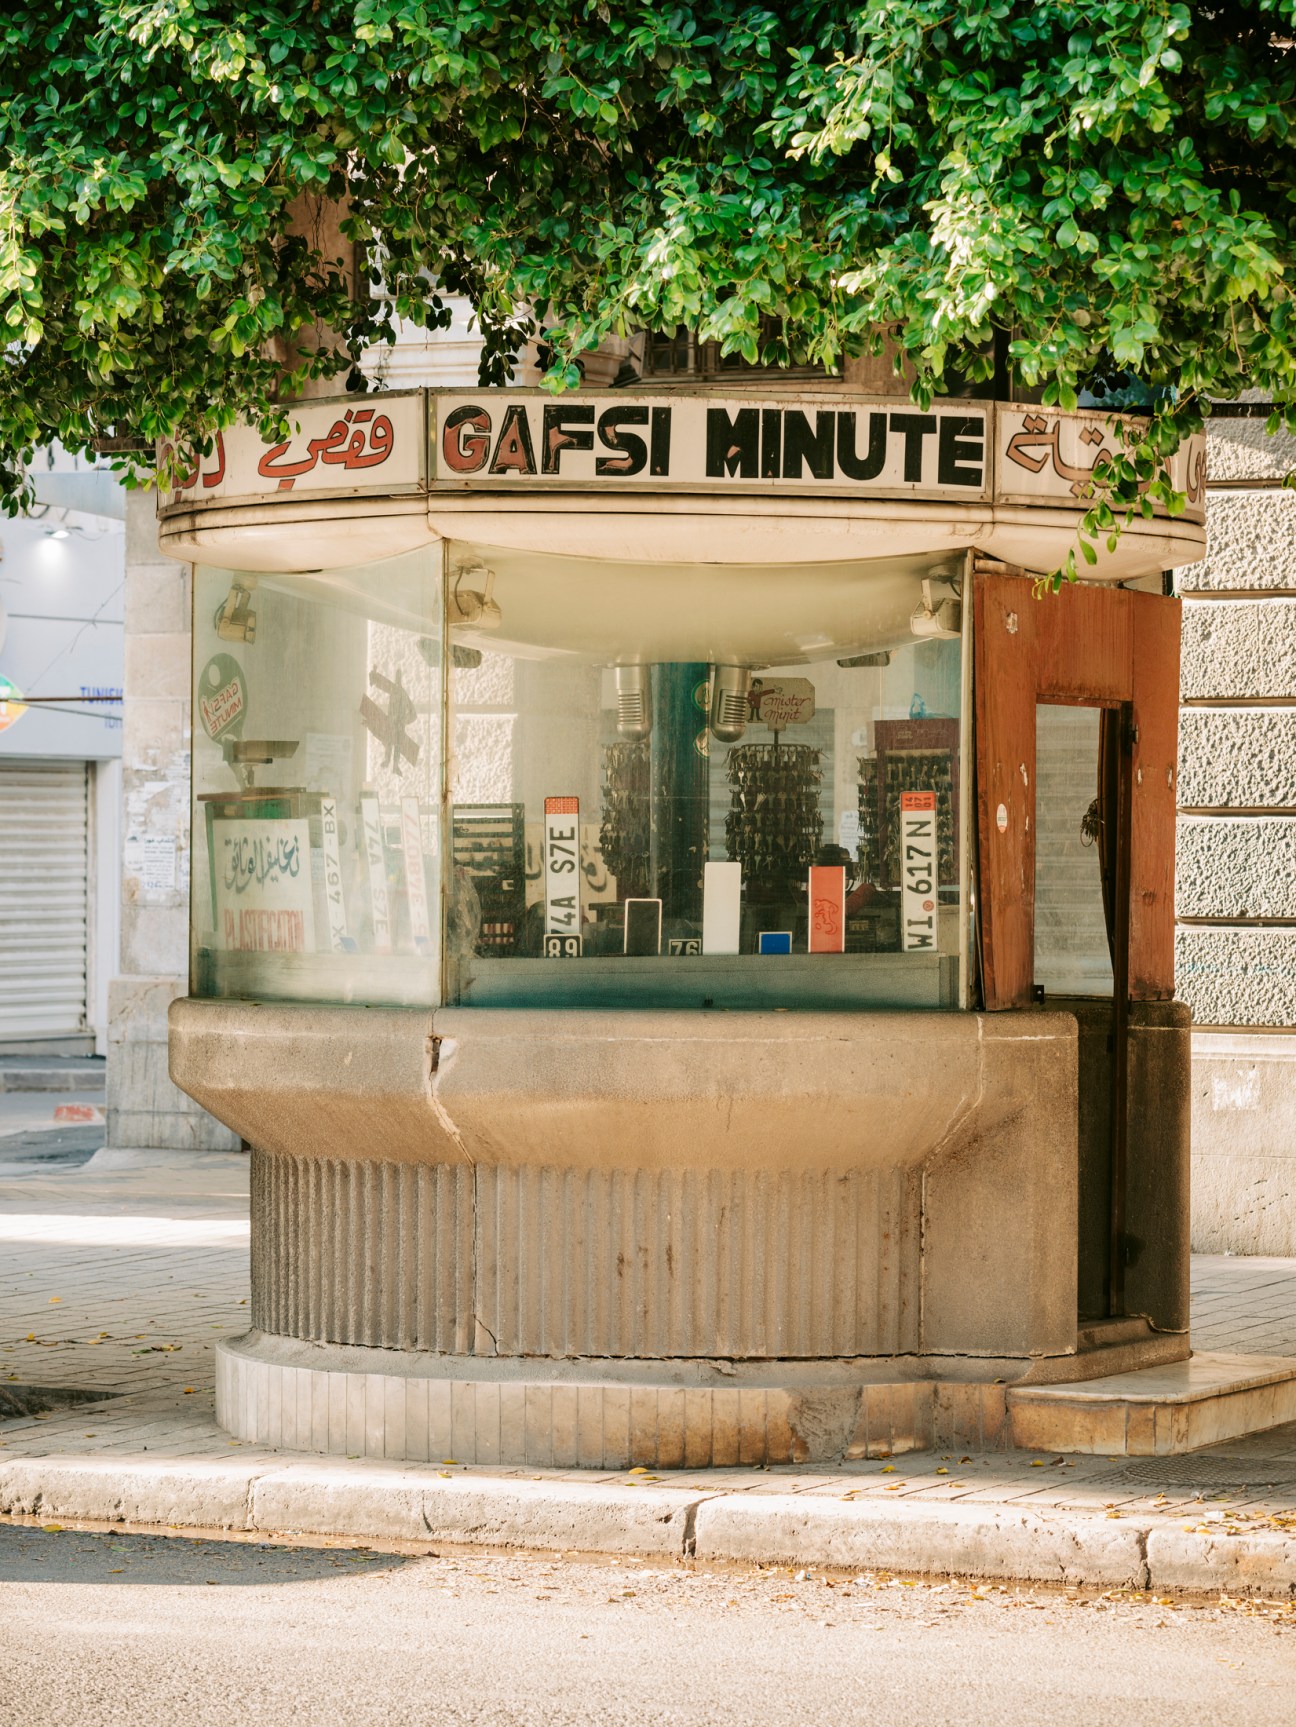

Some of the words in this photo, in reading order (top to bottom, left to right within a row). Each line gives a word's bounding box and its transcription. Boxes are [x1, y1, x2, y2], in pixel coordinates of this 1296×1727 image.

[258, 409, 394, 490] قفصي
[442, 404, 673, 476] GAFSI
[706, 407, 985, 487] MINUTE
[549, 826, 576, 874] S7E
[907, 915, 933, 949] WI
